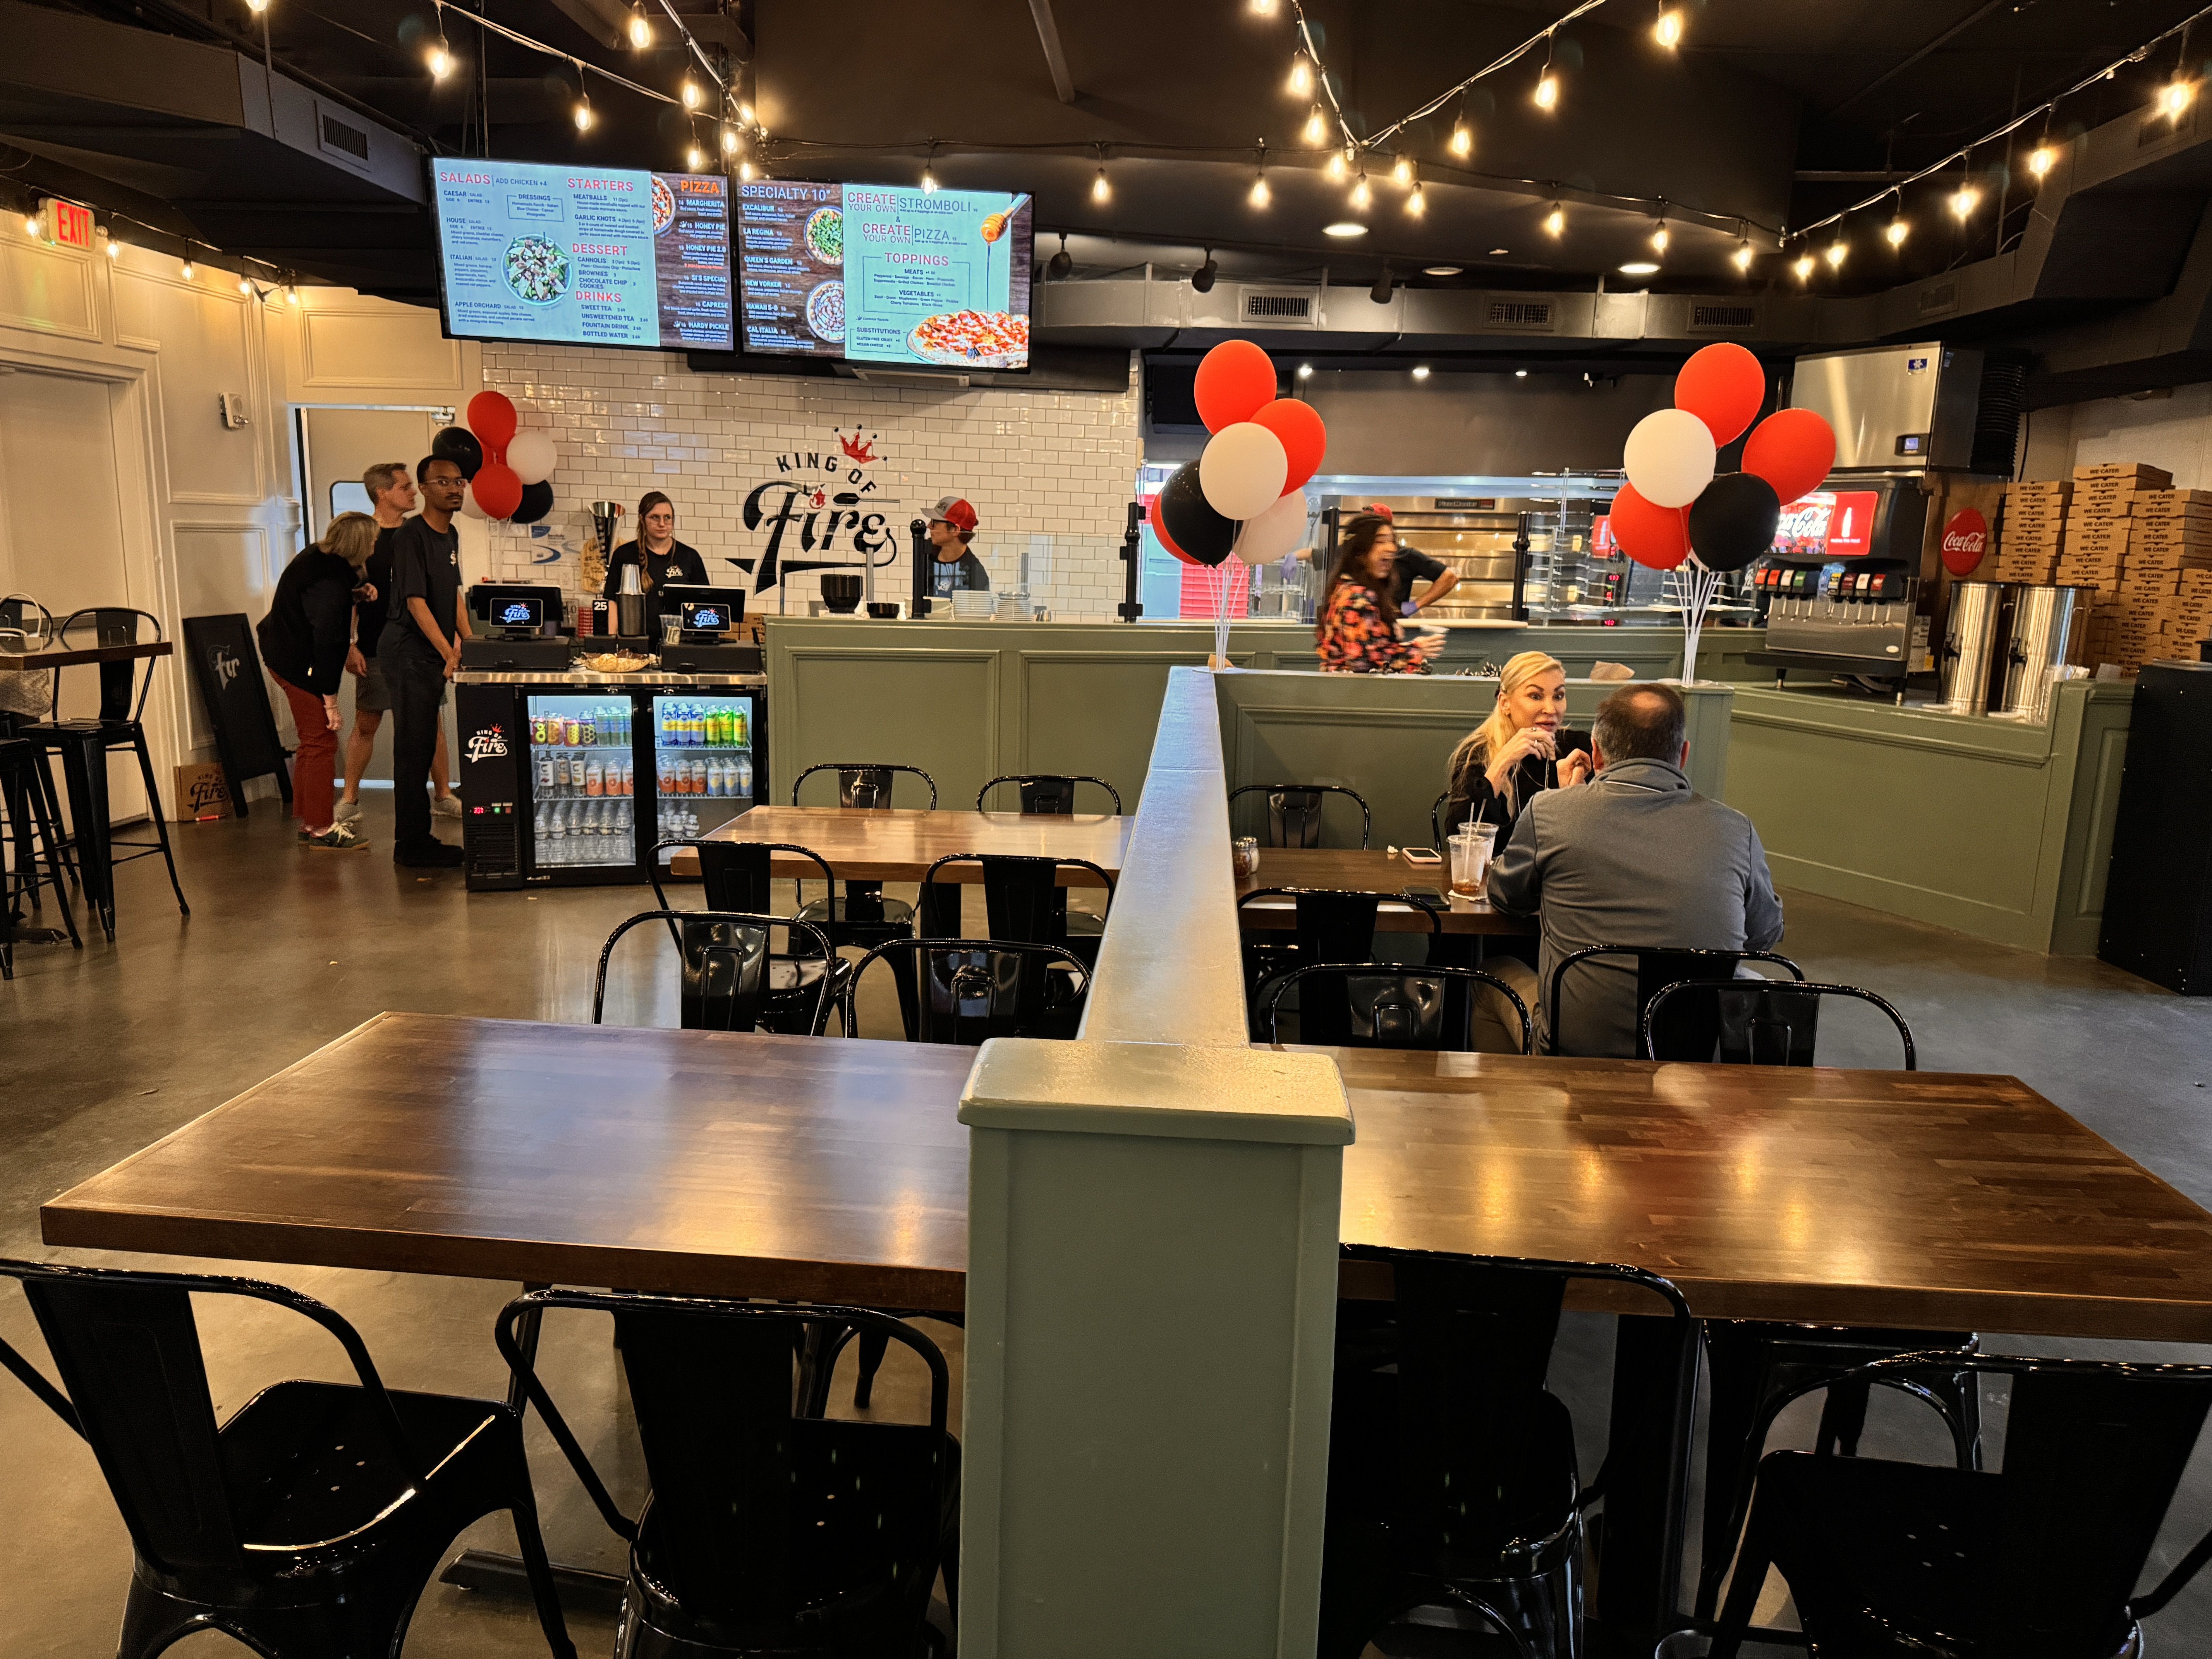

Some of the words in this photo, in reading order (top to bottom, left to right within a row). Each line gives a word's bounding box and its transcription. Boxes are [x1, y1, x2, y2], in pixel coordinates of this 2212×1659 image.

[440, 172, 491, 185] SALADS
[567, 178, 634, 192] STARTERS
[680, 180, 720, 194] PIZZA
[742, 185, 808, 201] SPECIALTY
[811, 188, 831, 202] 10"
[686, 198, 725, 208] MARGHERITA
[742, 203, 775, 212] EXCALIBUR
[847, 192, 896, 205] CREATE
[899, 198, 971, 212] STROMBOLI
[848, 203, 872, 212] YOUR
[875, 204, 896, 213] OWN
[56, 201, 90, 248] EXIT
[694, 221, 715, 230] HONEY
[715, 222, 726, 231] PIE
[743, 227, 752, 235] LA
[752, 228, 774, 236] REGINA
[862, 223, 911, 236] CREATE
[914, 228, 950, 240] PIZZA
[863, 234, 887, 242] YOUR
[890, 235, 910, 244] OWN
[572, 243, 628, 256] DESSERT
[685, 243, 706, 252] HONEY
[716, 245, 727, 253] 2.0
[744, 255, 769, 264] QUEEN'S
[769, 256, 793, 265] GARDEN
[884, 252, 949, 266] TOPPINGS
[745, 278, 759, 287] NEW
[759, 280, 782, 288] YORKER
[575, 290, 622, 303] DRINKS
[581, 313, 623, 321] UNSWEETENED
[688, 321, 708, 329] HARDY
[709, 322, 730, 331] PICKLE
[747, 325, 759, 333] CAL
[759, 326, 778, 335] ITALIA
[776, 452, 838, 473] KING
[848, 468, 877, 494] OF
[725, 480, 897, 596] Fire
[594, 601, 608, 611] 25
[502, 608, 530, 623] Fire
[693, 613, 720, 628] Fire
[464, 736, 508, 763] Fire
